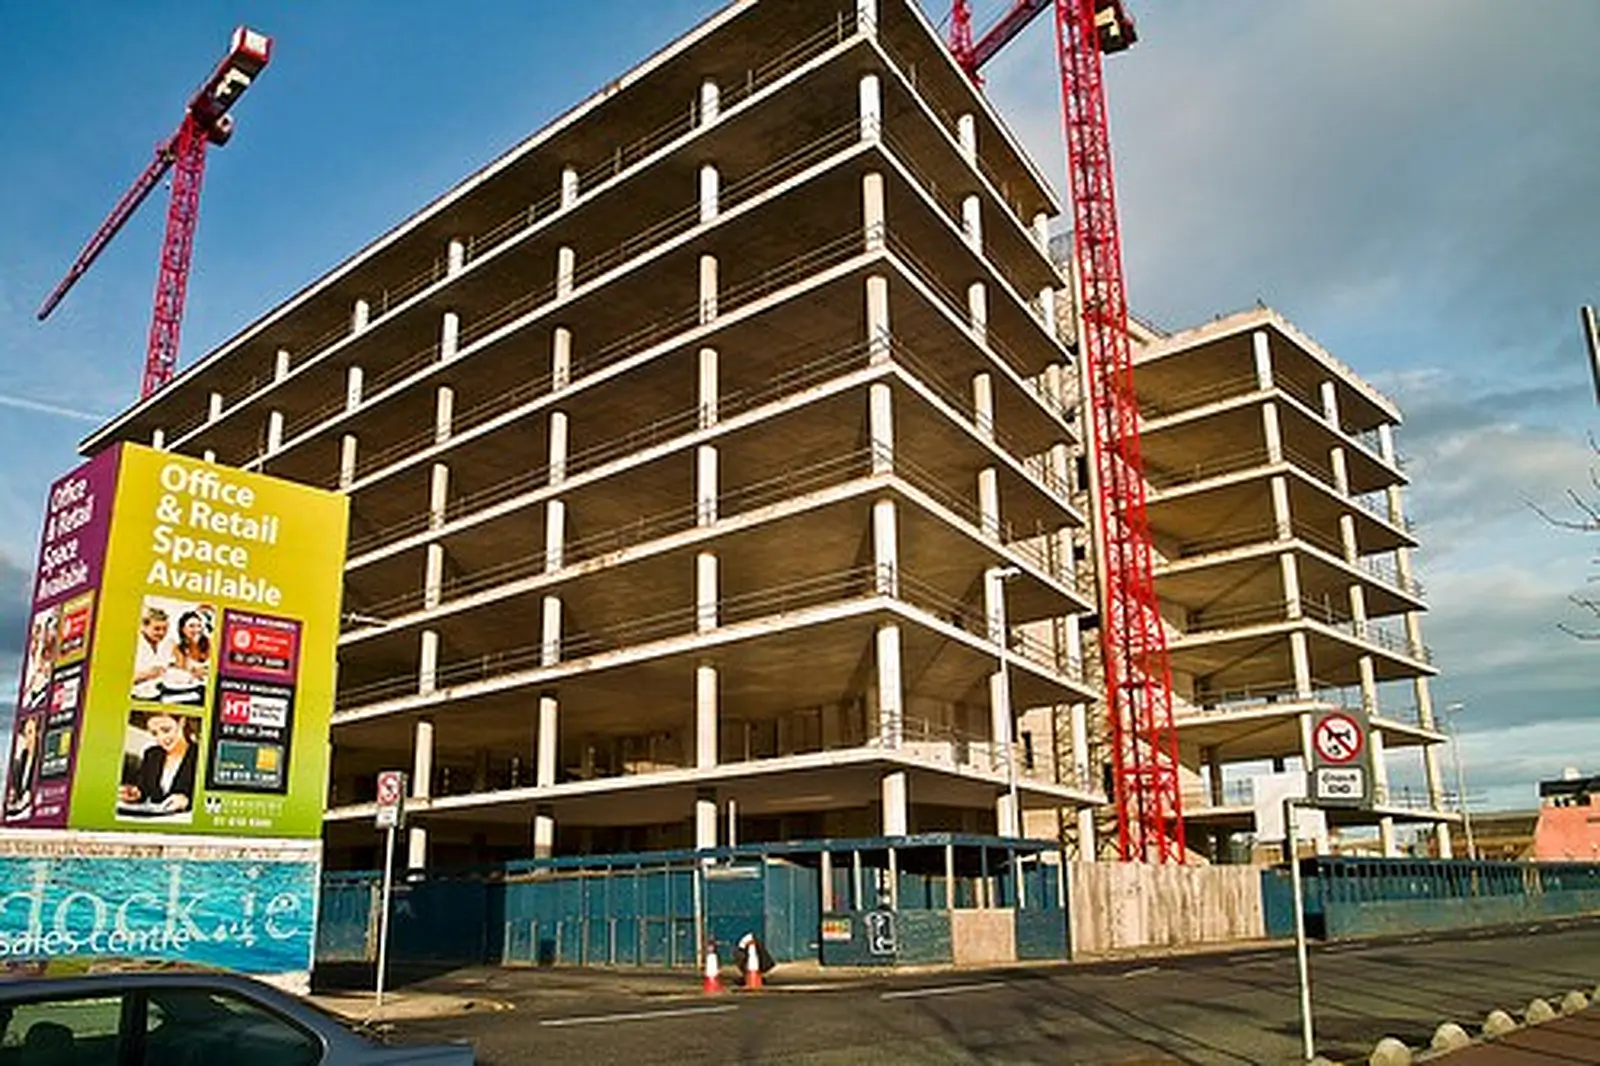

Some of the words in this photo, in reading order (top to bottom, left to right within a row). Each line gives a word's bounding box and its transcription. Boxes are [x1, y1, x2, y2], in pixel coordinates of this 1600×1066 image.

[160, 463, 255, 508] Office
[156, 494, 183, 524] &
[189, 500, 279, 544] Retail
[152, 525, 248, 569] Space
[147, 559, 282, 606] Available
